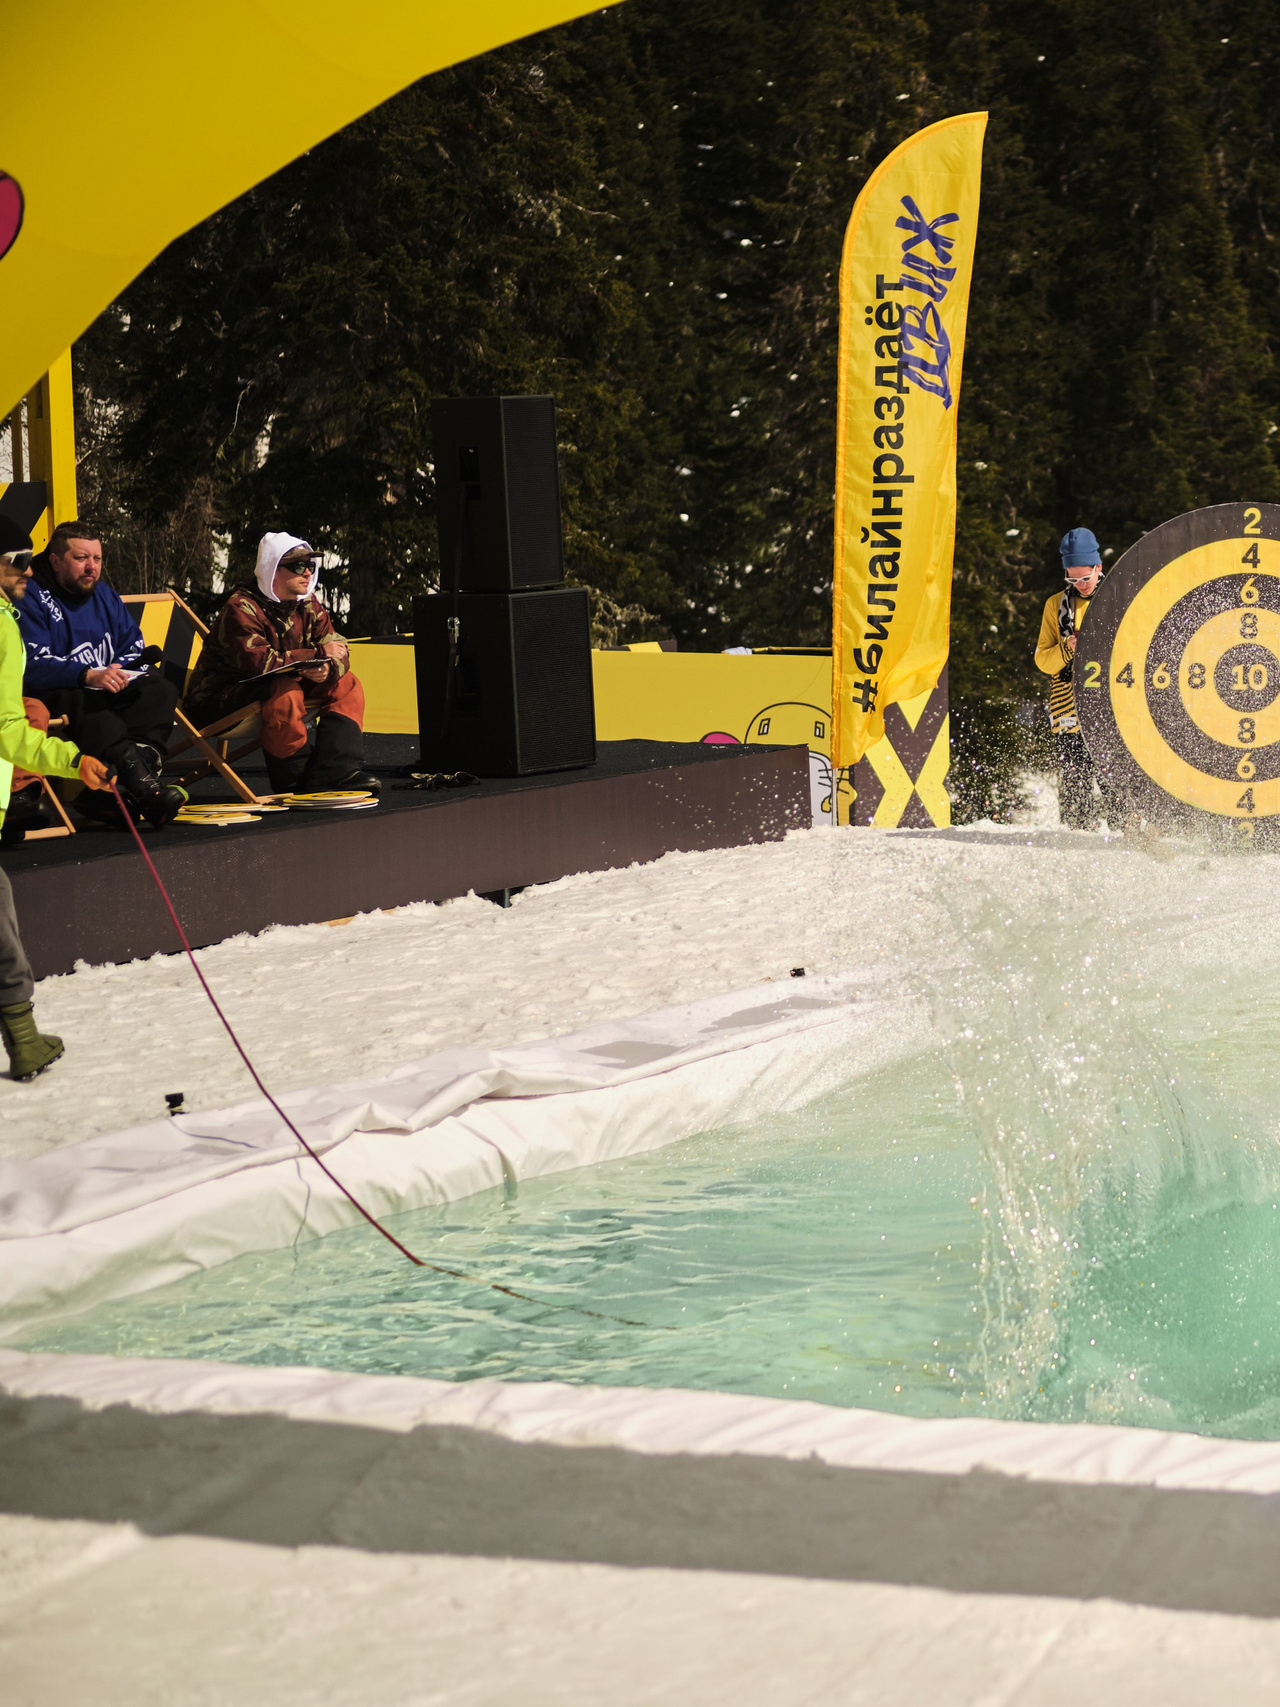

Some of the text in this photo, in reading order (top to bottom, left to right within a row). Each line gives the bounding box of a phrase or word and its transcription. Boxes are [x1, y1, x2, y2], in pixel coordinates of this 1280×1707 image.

[852, 274, 915, 714] #билайнраздаёт
[1243, 507, 1261, 534] 2
[1241, 543, 1260, 568] 4
[1240, 577, 1259, 604] 6
[1240, 612, 1258, 639] 8
[1083, 661, 1101, 688] 2
[1116, 662, 1135, 688] 4
[1152, 662, 1171, 689] 6
[1188, 663, 1206, 689] 8
[1231, 663, 1268, 690] 10
[1237, 717, 1256, 743] 8
[1236, 752, 1256, 779] 6
[1236, 787, 1255, 813] 4
[1238, 821, 1255, 847] 2
